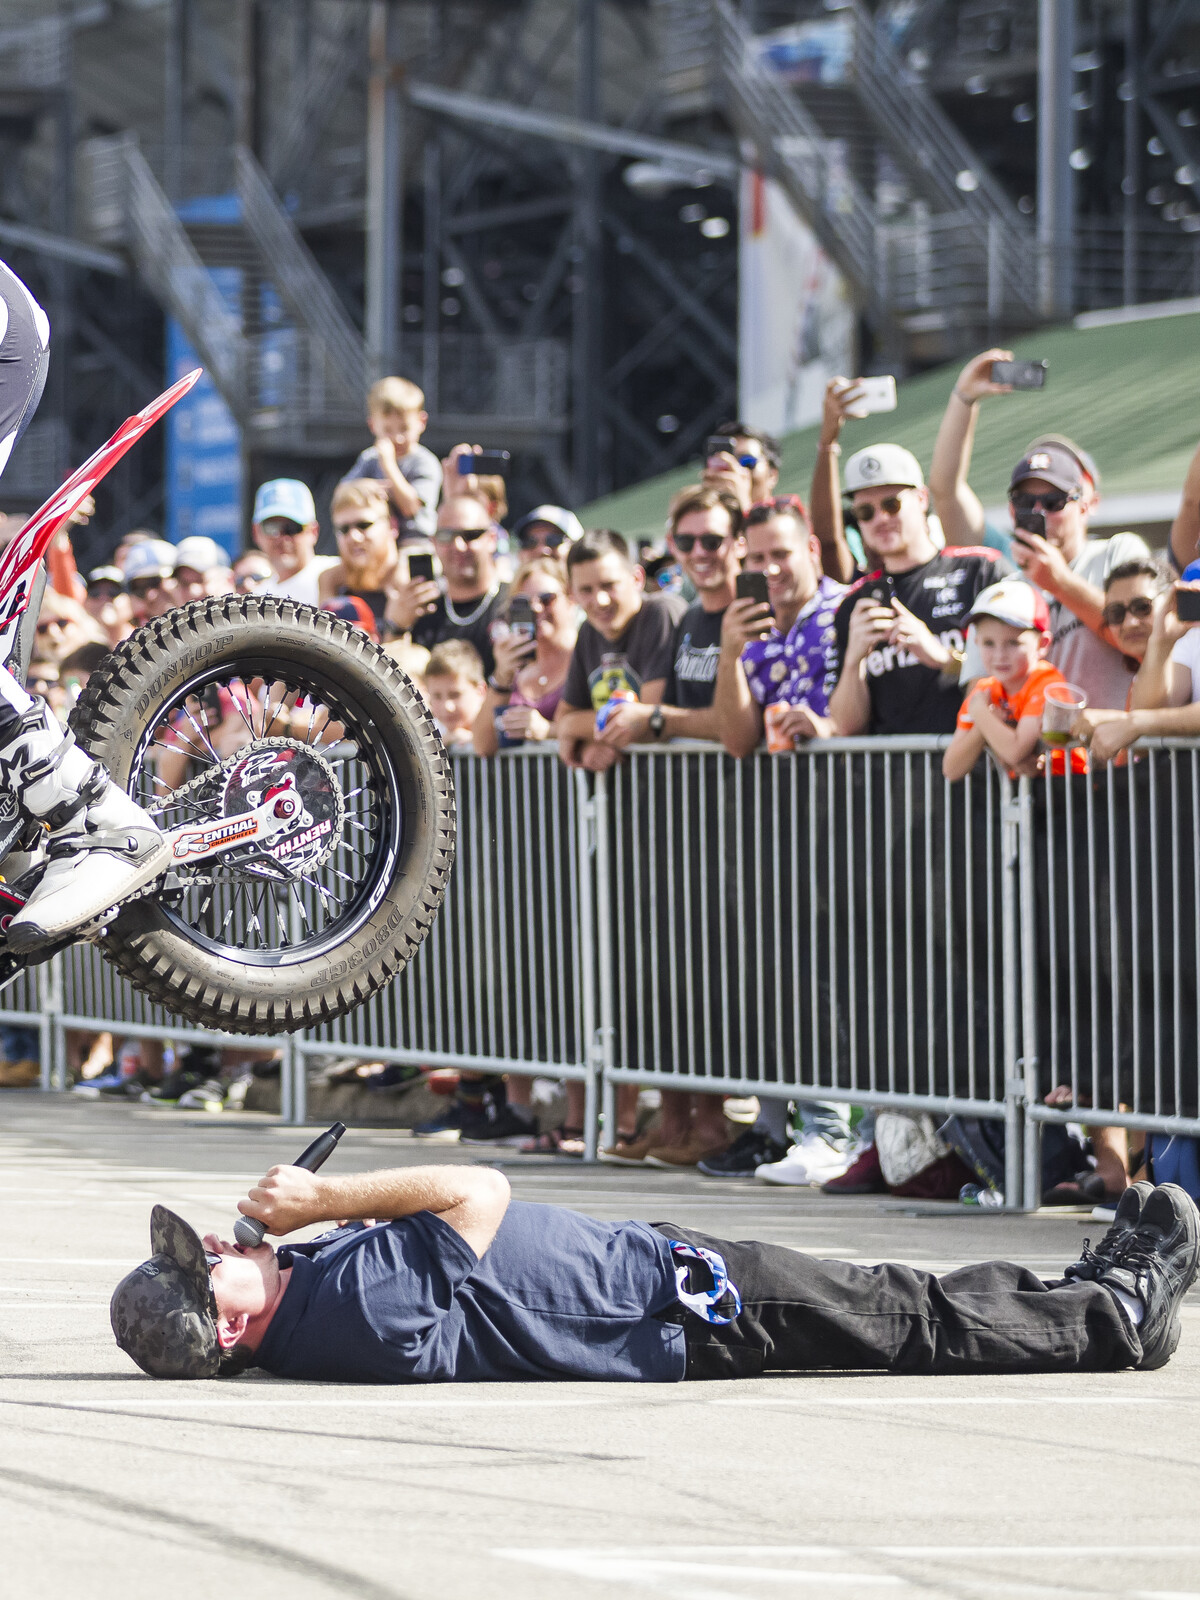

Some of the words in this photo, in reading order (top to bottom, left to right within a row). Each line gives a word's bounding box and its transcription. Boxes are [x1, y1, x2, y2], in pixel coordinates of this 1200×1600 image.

[134, 634, 235, 720] DUNLOP
[210, 828, 257, 848] CHAINWHEELS
[269, 818, 332, 858] RENTHA
[310, 904, 404, 988] D803GP
